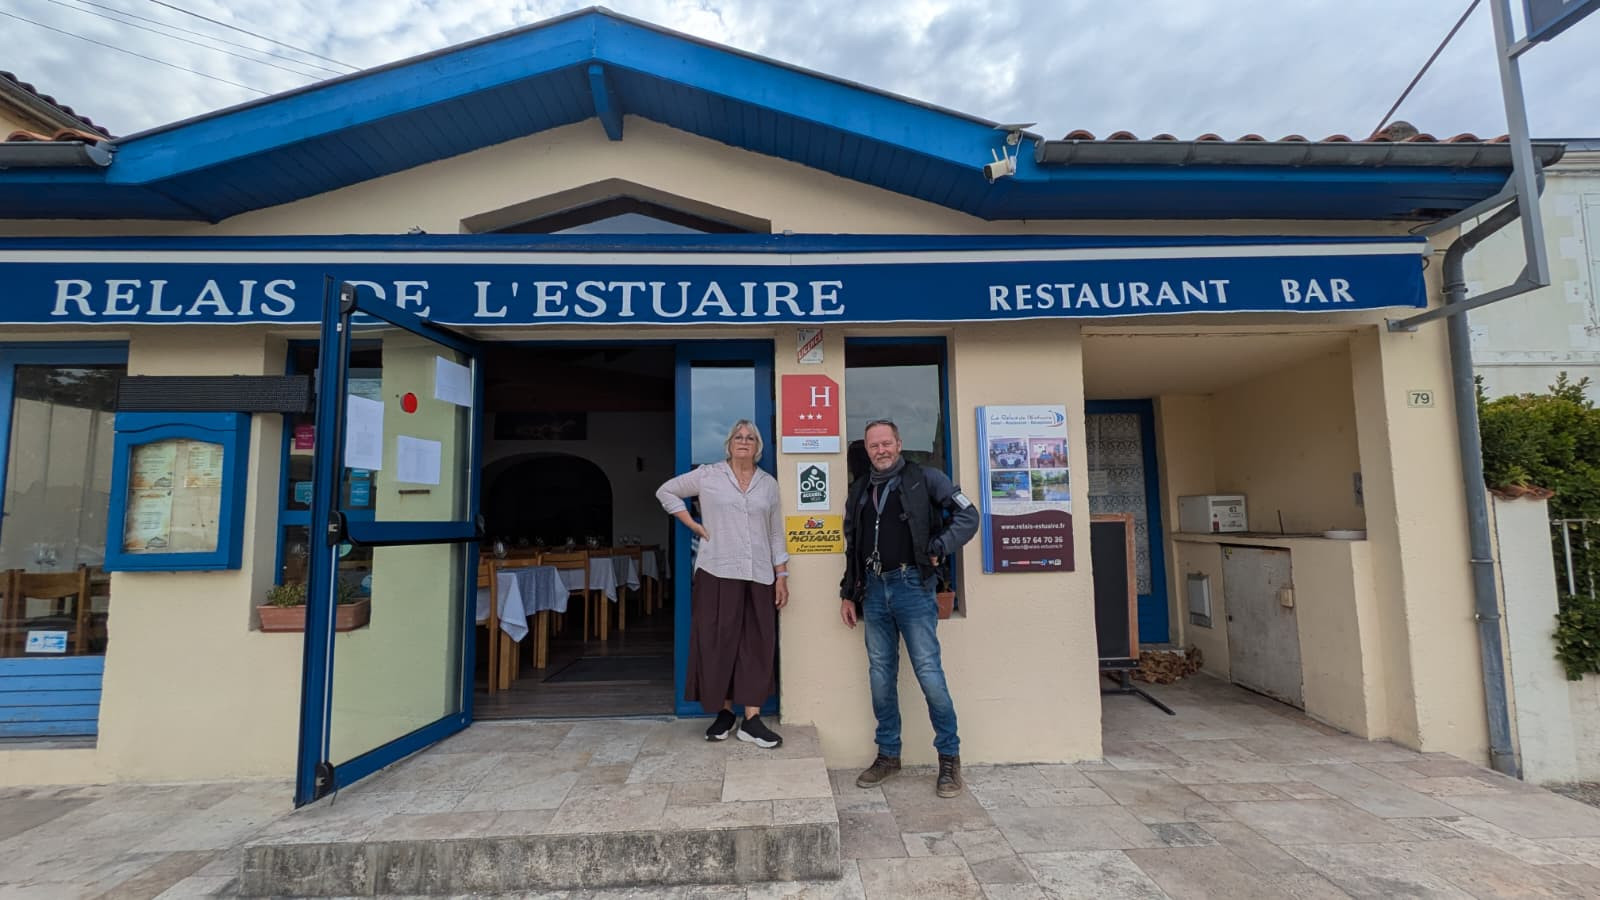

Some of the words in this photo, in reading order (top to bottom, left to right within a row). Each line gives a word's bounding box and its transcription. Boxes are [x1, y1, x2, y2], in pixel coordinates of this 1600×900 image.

[51, 279, 296, 316] RELAIS
[474, 281, 845, 318] L'ESTUAIRE
[989, 279, 1230, 311] RESTAURANT
[1281, 279, 1355, 304] BAR
[810, 386, 831, 408] H
[1412, 393, 1430, 405] 79
[1011, 536, 1021, 544] 05
